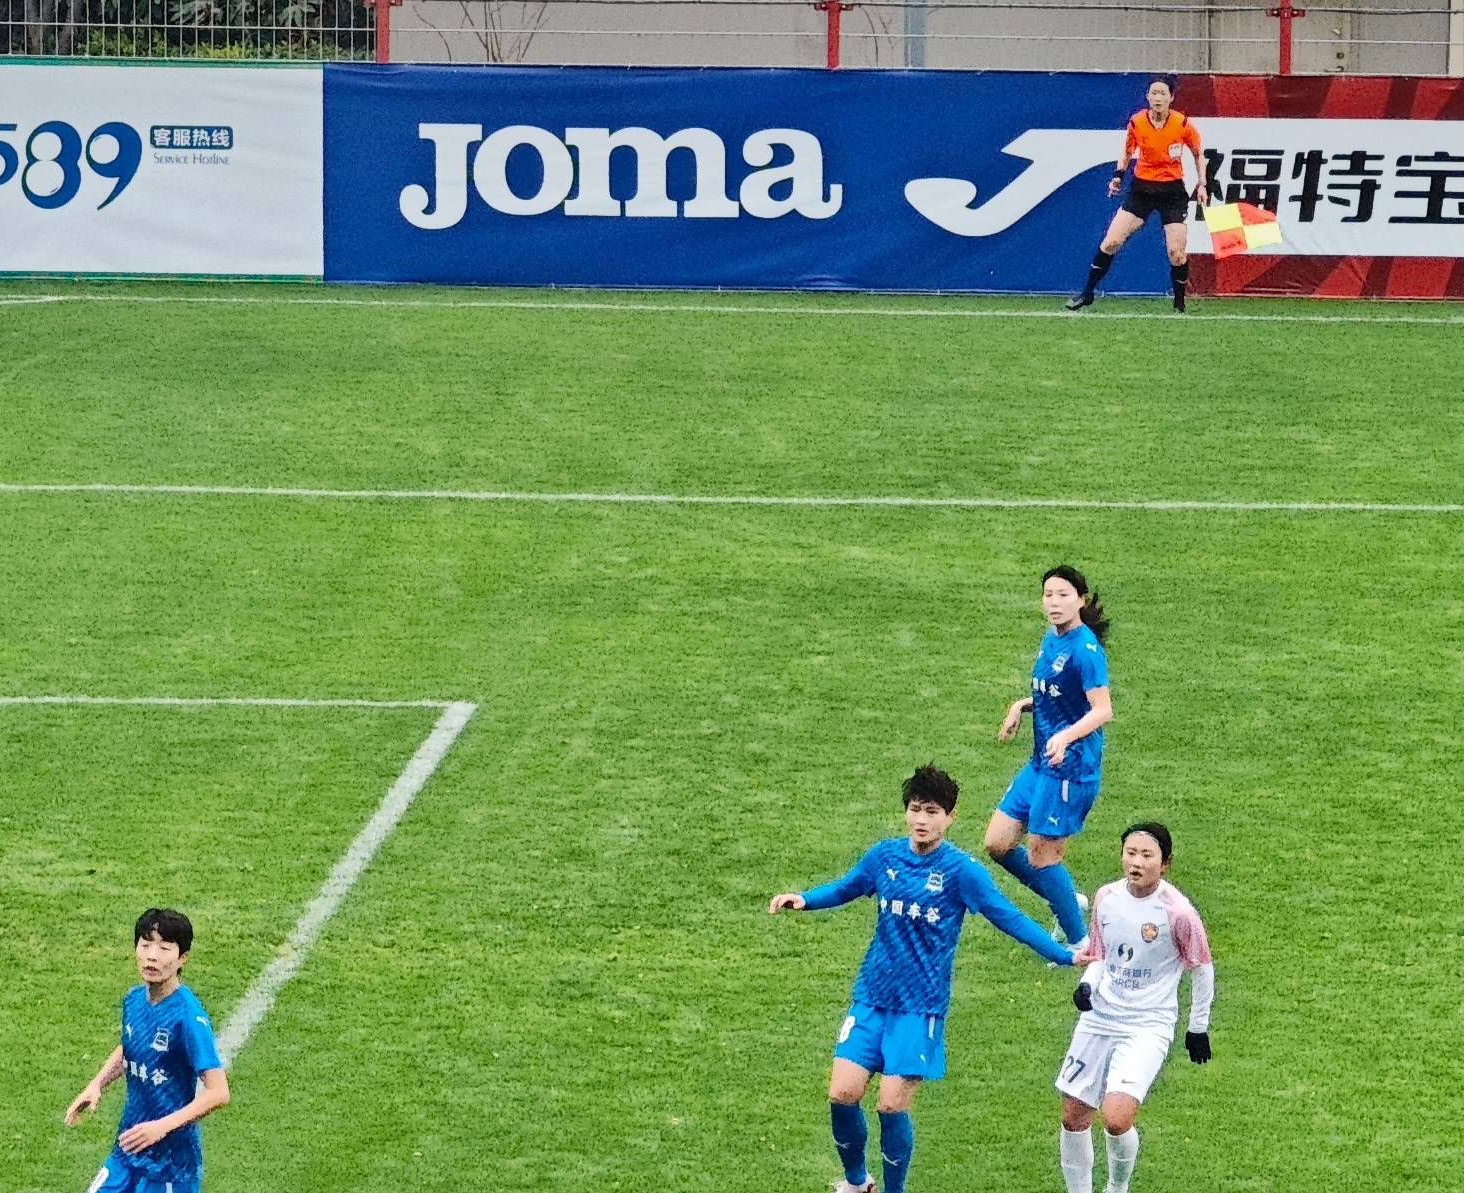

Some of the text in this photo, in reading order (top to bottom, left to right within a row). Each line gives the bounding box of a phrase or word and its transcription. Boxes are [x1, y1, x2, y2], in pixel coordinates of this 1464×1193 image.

[153, 128, 230, 148] 客服热线
[399, 123, 843, 230] Joma
